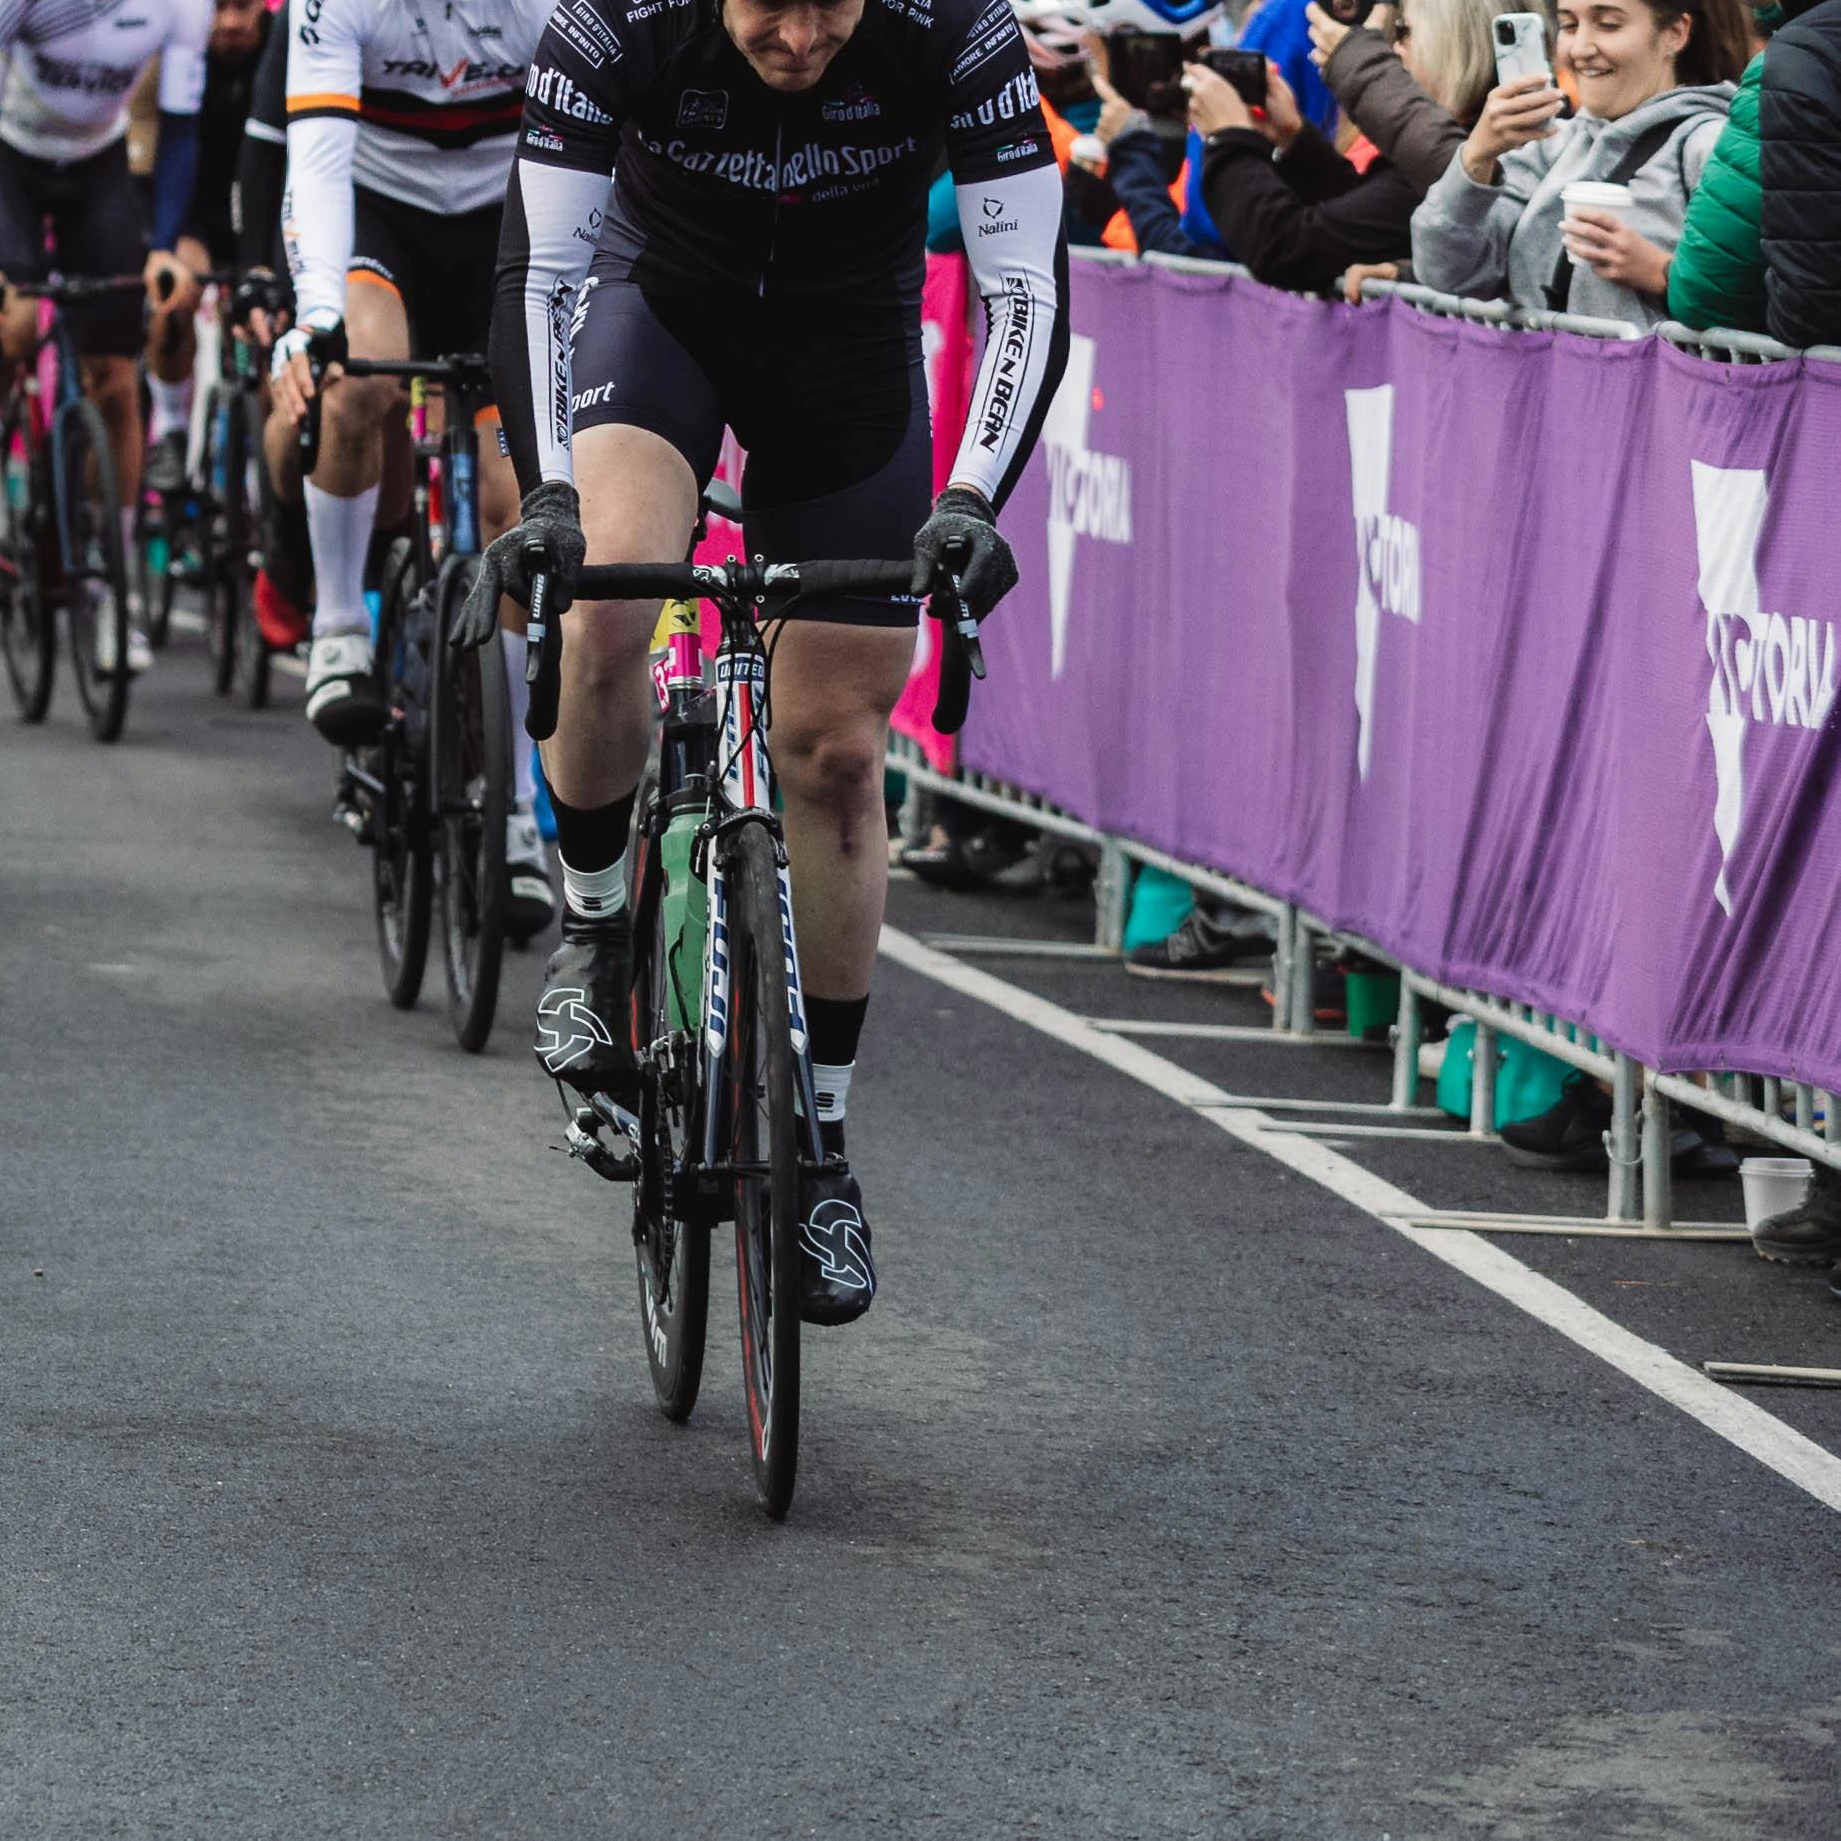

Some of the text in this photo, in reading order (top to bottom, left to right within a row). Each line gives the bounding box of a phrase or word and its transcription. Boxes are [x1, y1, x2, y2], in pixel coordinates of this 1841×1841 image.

[577, 7, 594, 25] GIRO
[626, 1, 663, 23] FIGHT
[908, 7, 935, 30] PINK
[568, 25, 599, 59] INFINITO
[953, 48, 983, 76] AMORE
[840, 136, 918, 176] Sport
[978, 219, 1018, 237] Nalini
[1005, 297, 1029, 359] BIKE
[572, 381, 615, 413] port
[532, 573, 546, 619] SRAM
[709, 877, 730, 1038] FUJI
